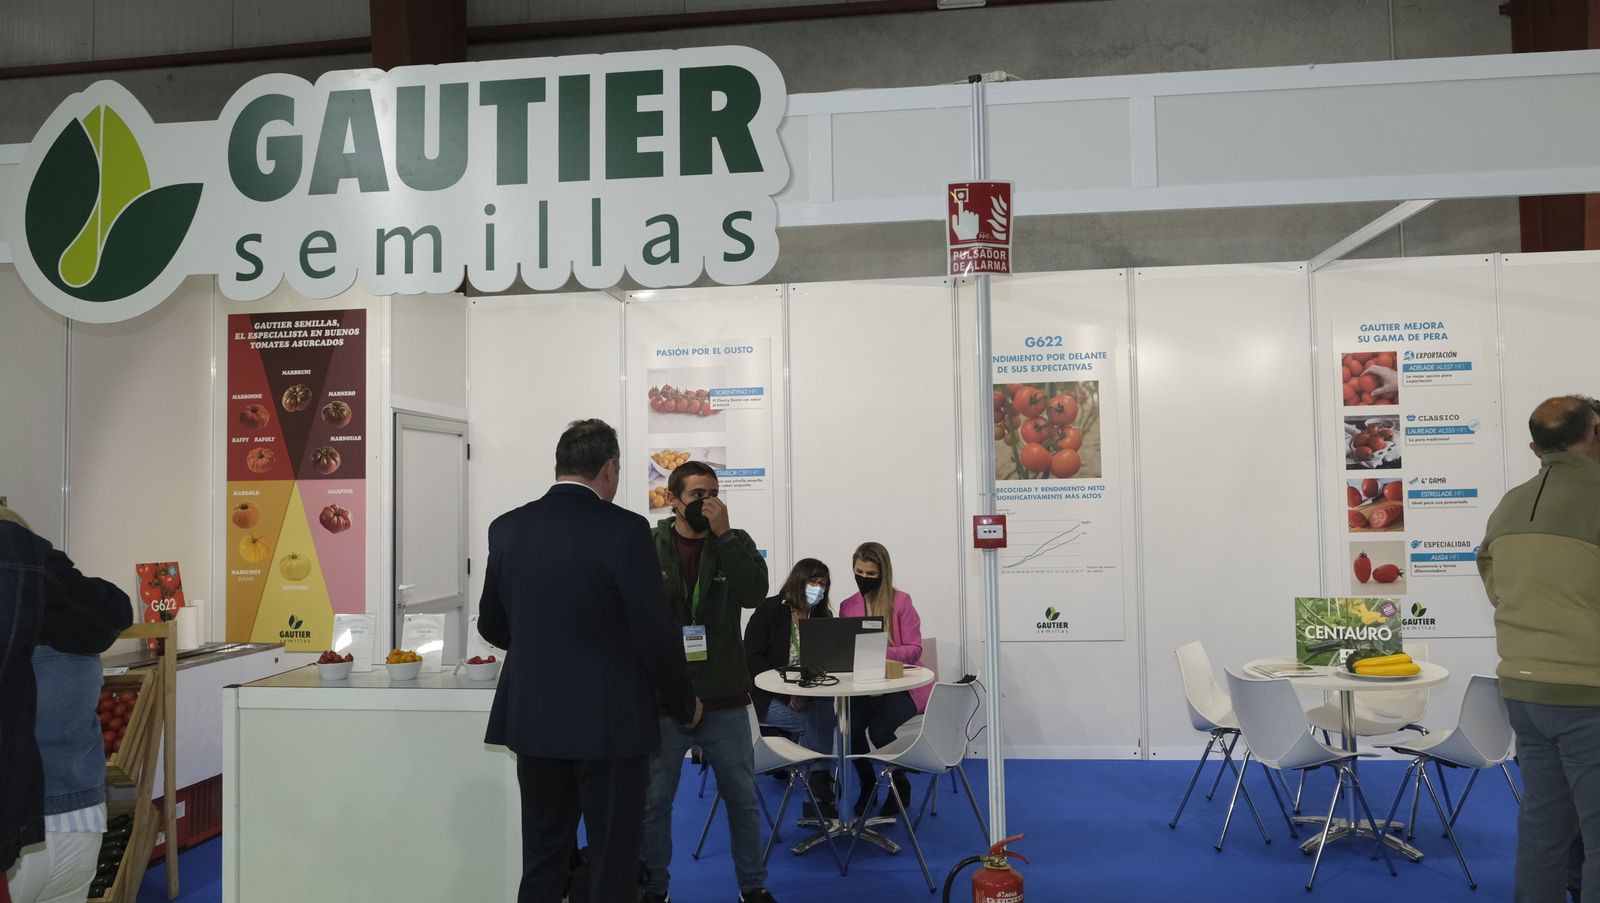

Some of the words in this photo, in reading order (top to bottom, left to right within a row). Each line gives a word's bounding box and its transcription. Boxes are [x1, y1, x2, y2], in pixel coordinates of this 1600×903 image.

[228, 64, 763, 202] GAUTIER
[235, 197, 755, 282] semillas
[953, 249, 1006, 260] PULSADOR
[953, 262, 965, 272] DE
[966, 261, 1008, 272] ALARMA
[254, 322, 292, 330] GAUTIER
[294, 319, 340, 328] SEMILLAS,
[1360, 323, 1400, 332] GAUTIER
[1404, 322, 1444, 330] MEJORA
[248, 330, 308, 340] ESPECIALISTA
[324, 328, 360, 336] BUENOS
[1357, 335, 1370, 343] SU
[1374, 334, 1404, 342] GAMA
[1423, 332, 1448, 340] PERA
[250, 340, 290, 349] TOMATES
[292, 339, 344, 348] ASURCADOS
[1024, 336, 1063, 348] G622
[656, 346, 688, 357] PASIÓN
[692, 348, 710, 356] POR
[724, 346, 754, 354] GUSTO
[1416, 350, 1457, 360] EXPORTACIÓN
[992, 354, 1044, 363] NDIMIENTO
[1068, 352, 1107, 360] DELANTE
[1011, 365, 1028, 373] SUS
[1031, 362, 1092, 372] EXPECTATIVAS
[151, 598, 177, 612] G622
[280, 630, 311, 638] GAUTIER
[1305, 625, 1392, 641] CENTAURO
